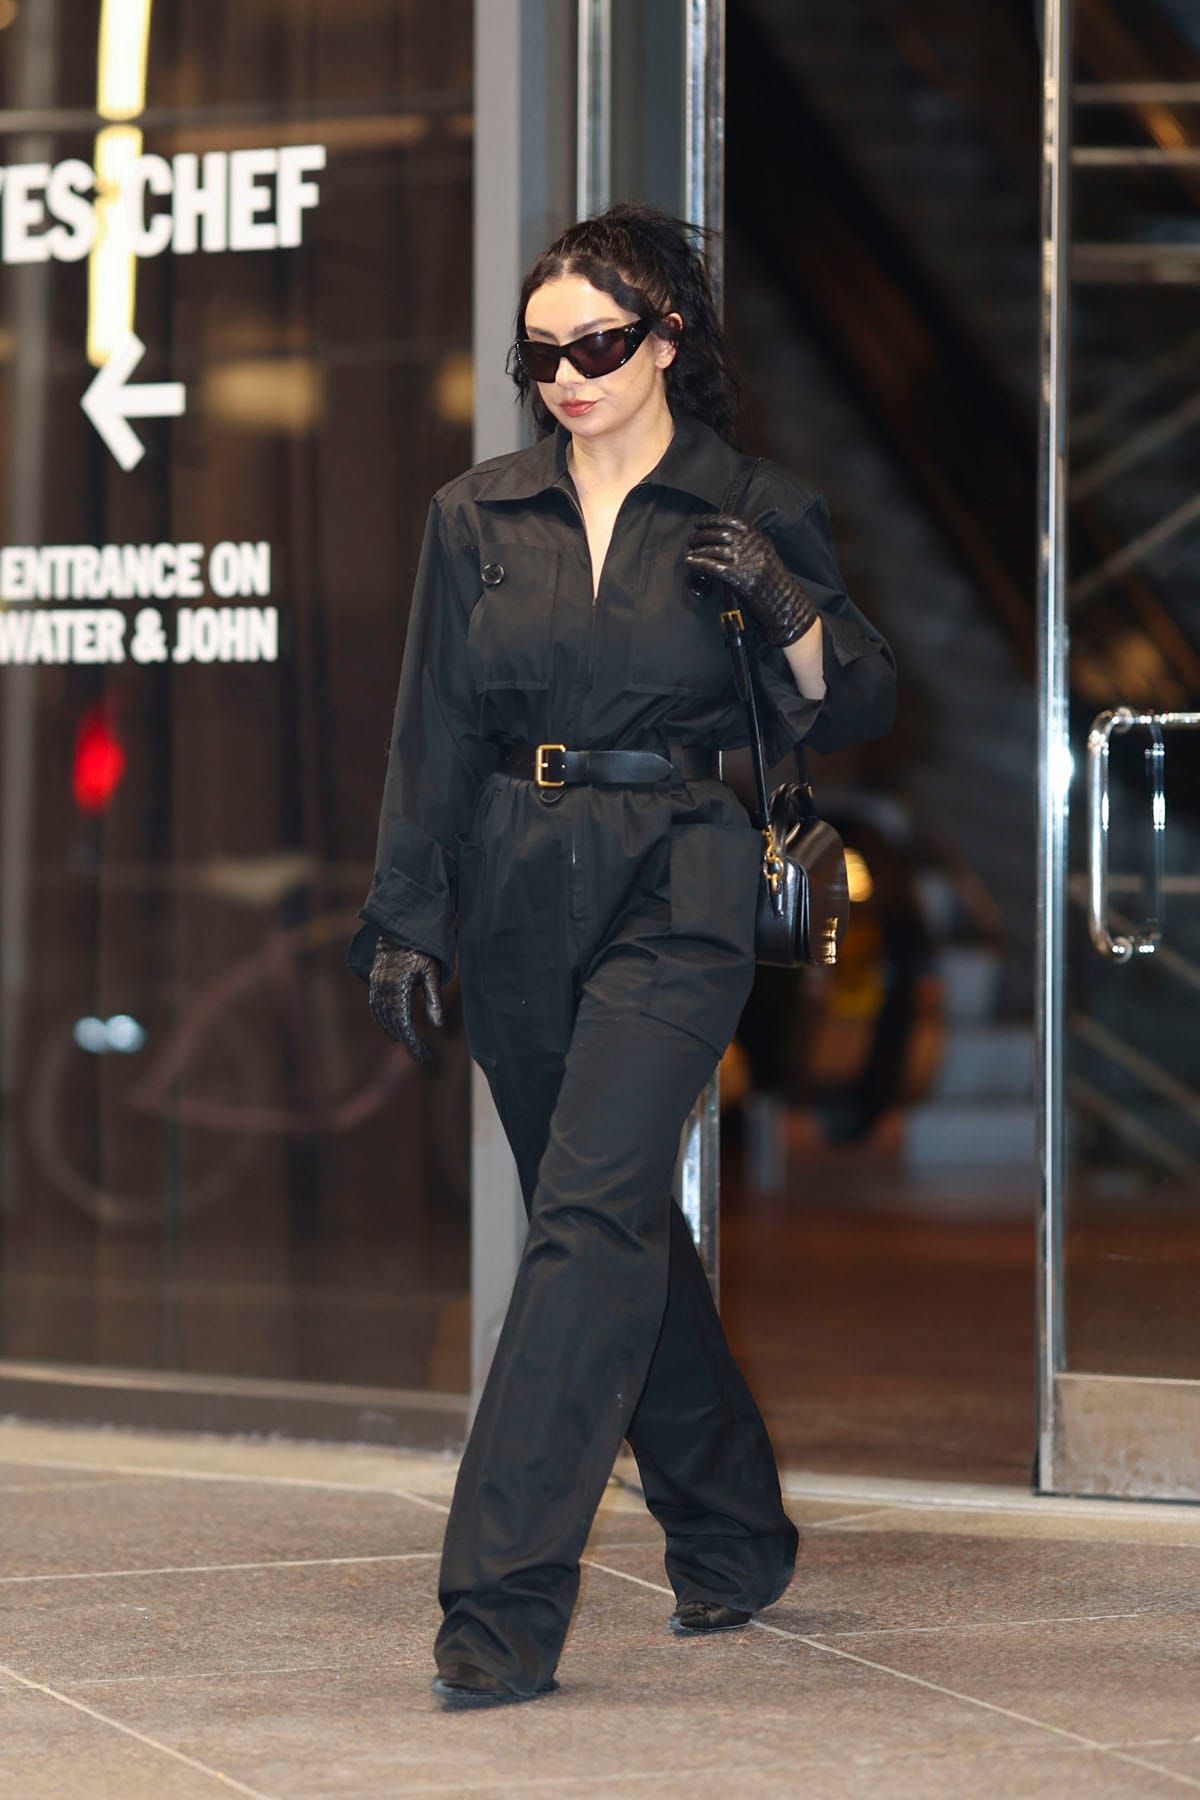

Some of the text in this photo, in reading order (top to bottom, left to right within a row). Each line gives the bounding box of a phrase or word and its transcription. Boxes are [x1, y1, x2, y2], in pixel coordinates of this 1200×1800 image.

[0, 145, 326, 263] ES CHEF
[1, 541, 271, 600] ENTRANCE ON
[0, 606, 278, 664] WATER & JOHN
